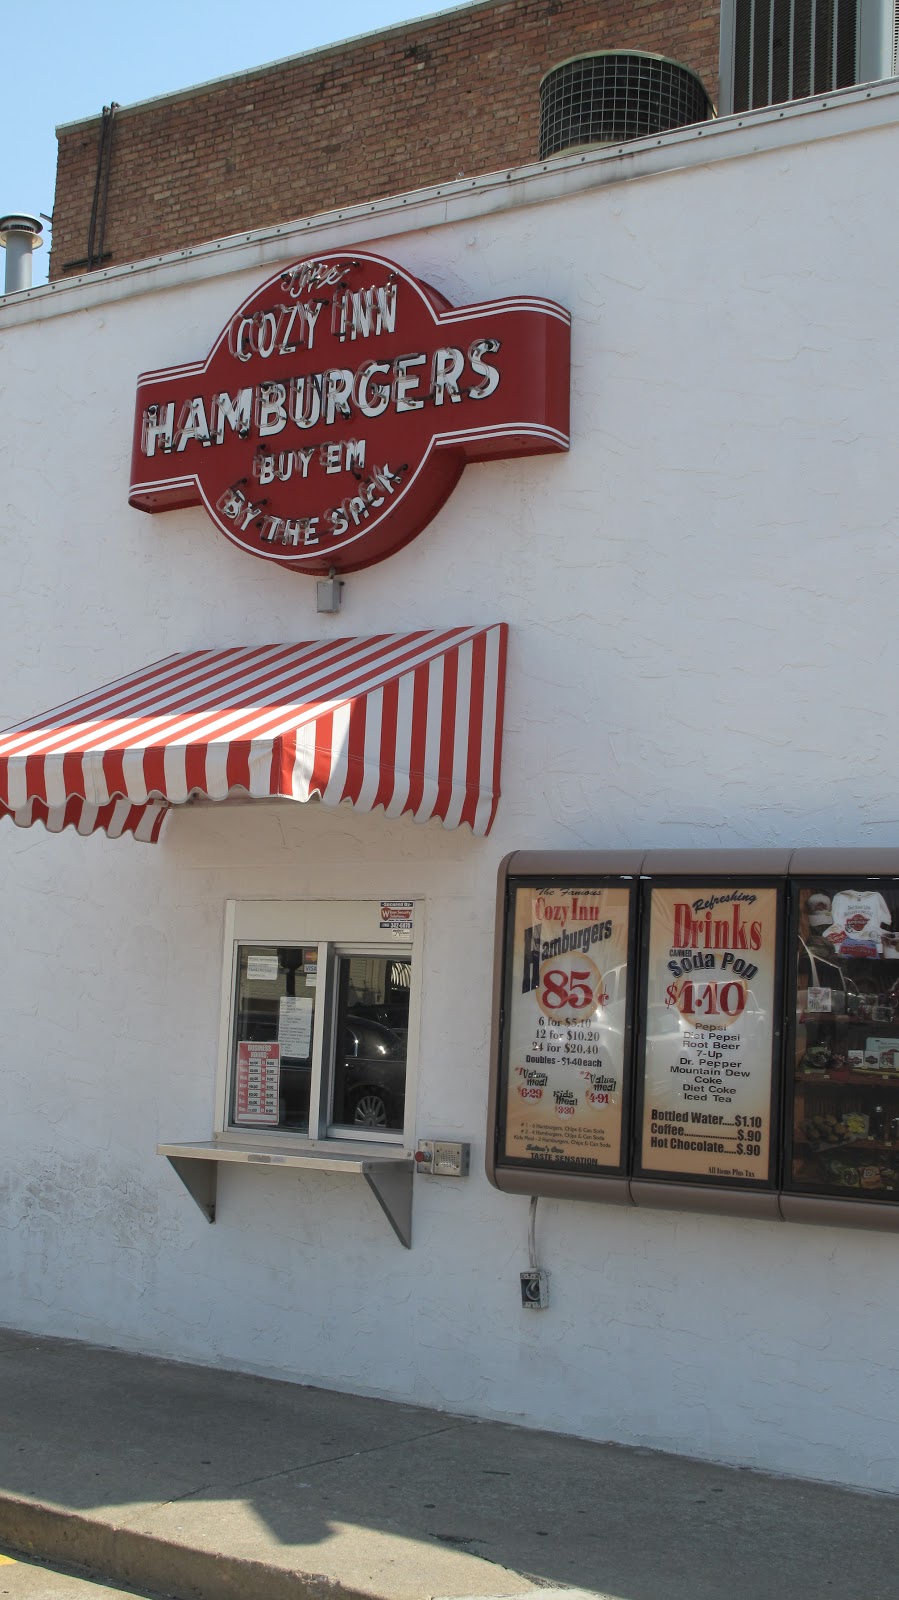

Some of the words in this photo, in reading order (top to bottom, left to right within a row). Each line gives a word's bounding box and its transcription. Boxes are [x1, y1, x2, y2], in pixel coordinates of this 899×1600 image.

[281, 260, 351, 298] The
[229, 301, 323, 362] COZY
[330, 284, 398, 342] INN
[141, 339, 501, 457] HAMBURGERS
[253, 447, 312, 484] BUY
[320, 438, 367, 472] EM
[218, 487, 260, 532] BY
[260, 515, 319, 547] THE
[325, 463, 402, 536] SACK
[536, 888, 555, 896] The
[560, 888, 602, 897] Famous
[692, 890, 757, 914] Refreshing
[535, 897, 570, 927] Cozy
[571, 897, 600, 921] Inn
[672, 903, 762, 951] Drinks
[522, 919, 612, 994] Hamburgers
[667, 951, 715, 978] Soda
[721, 951, 759, 980] Pop
[665, 980, 745, 1017] $1.10
[538, 1016, 545, 1026] 6
[547, 1017, 562, 1027] for
[565, 1017, 592, 1029] $5.10
[695, 1022, 727, 1032] Pepsi
[535, 1028, 546, 1039] 12
[549, 1030, 564, 1039] for
[566, 1030, 600, 1042] $10.20
[683, 1031, 705, 1040] Diet
[708, 1032, 741, 1042] Pepsi
[531, 1041, 544, 1052] 24
[546, 1043, 562, 1052] for
[563, 1042, 599, 1055] $20.40
[682, 1040, 709, 1049] Root
[712, 1041, 741, 1050] Beer
[525, 1054, 556, 1065] Doubles
[583, 1058, 602, 1067] each
[696, 1049, 723, 1060] 7-Up
[680, 1057, 694, 1066] Dr.
[699, 1058, 742, 1069] Pepper
[670, 1066, 721, 1076] Mountain
[725, 1069, 751, 1077] Dew
[694, 1075, 723, 1085] Coke
[682, 1083, 705, 1093] Diet
[708, 1085, 737, 1095] Coke
[684, 1092, 708, 1102] Iced
[712, 1094, 732, 1103] Tea
[651, 1109, 689, 1123] Bottled
[650, 1136, 668, 1149] Hot
[530, 1152, 553, 1161] TASTE
[555, 1155, 598, 1165] SENSATION
[708, 1166, 716, 1174] All
[732, 1168, 744, 1177] Plus
[744, 1169, 756, 1178] Tax
